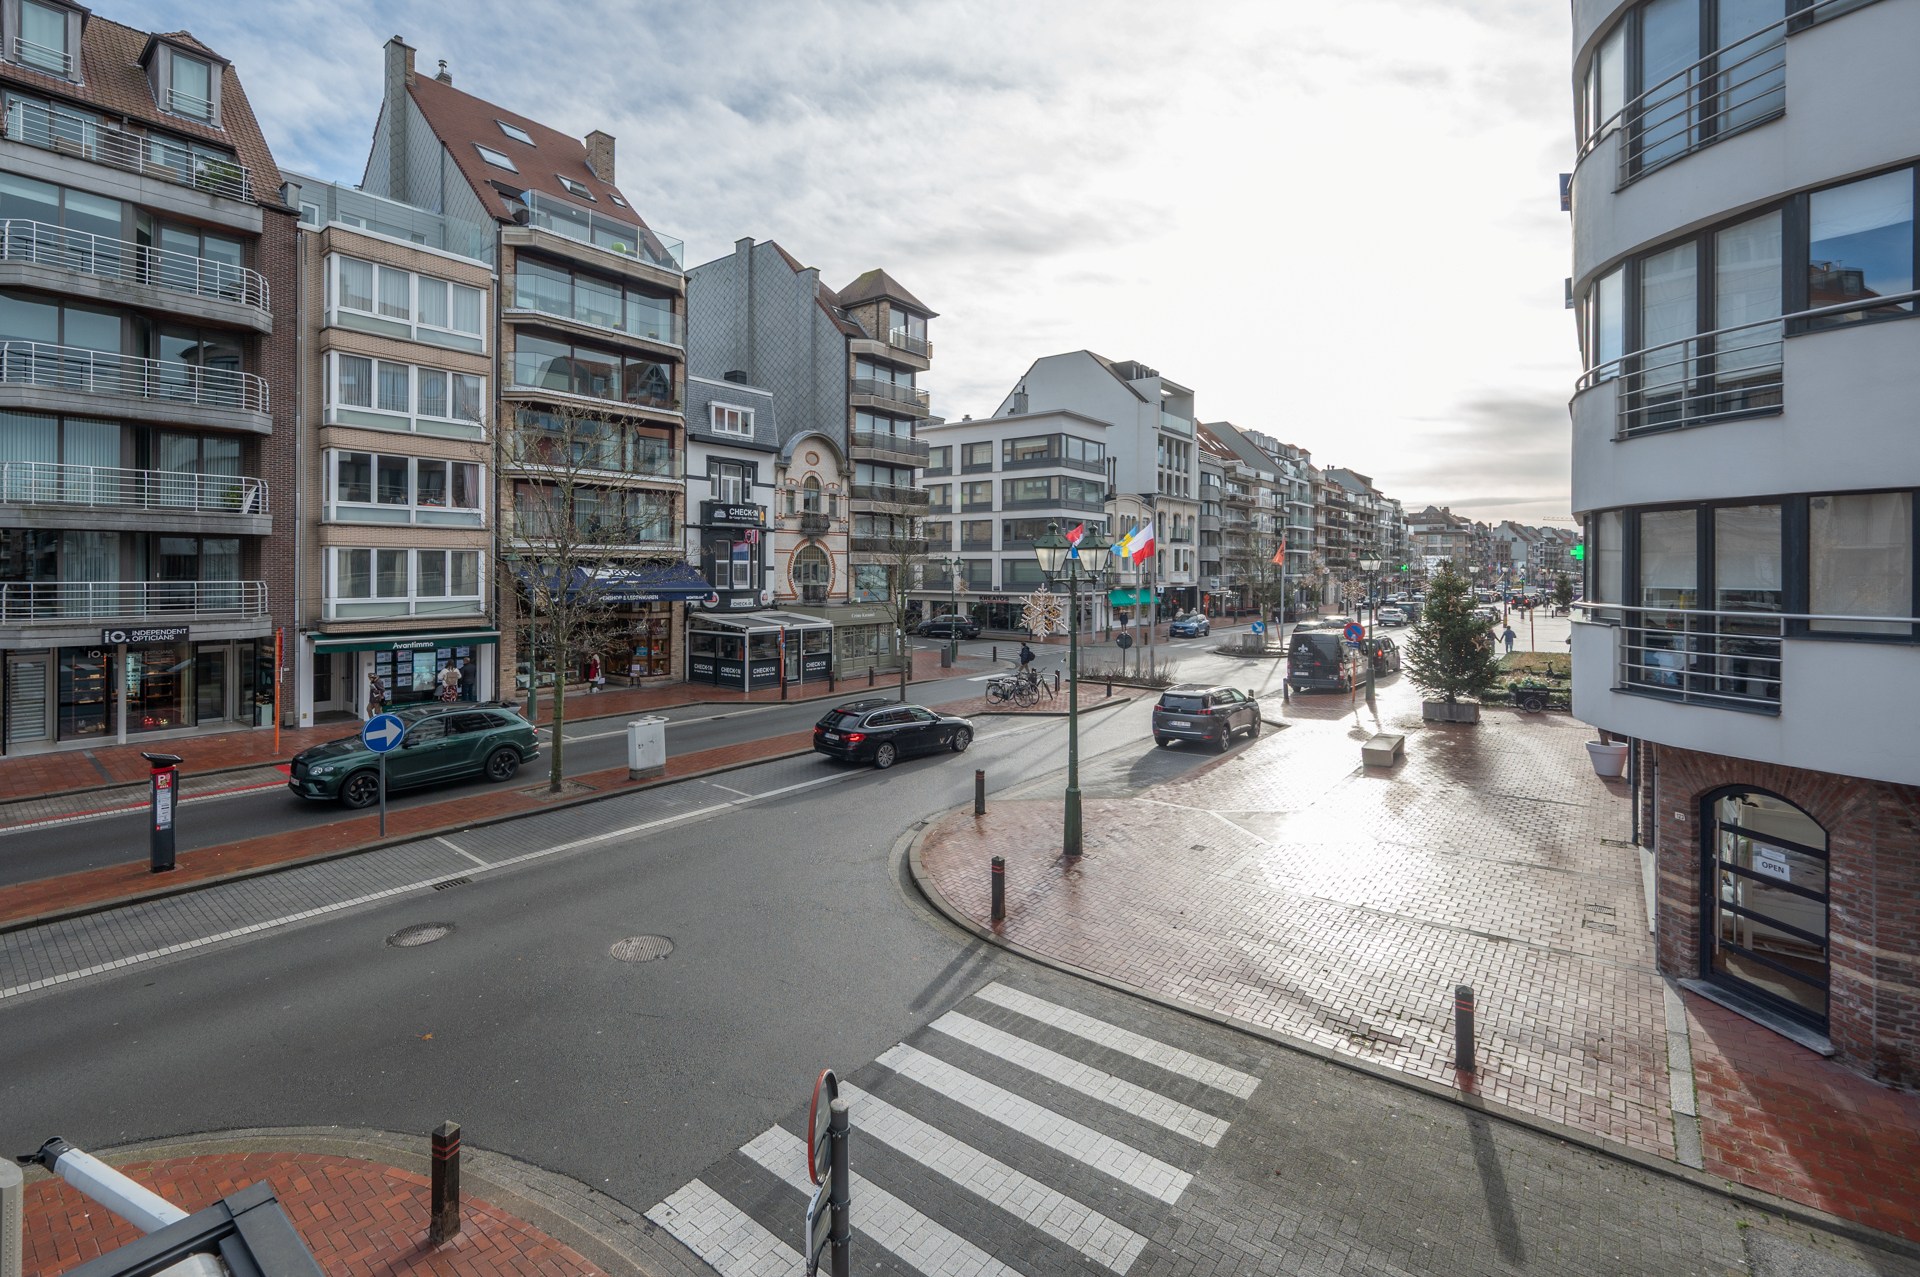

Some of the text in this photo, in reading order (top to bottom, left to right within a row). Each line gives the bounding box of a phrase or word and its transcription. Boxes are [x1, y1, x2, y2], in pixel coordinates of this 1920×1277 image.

[132, 628, 187, 636] INDEPENDENT
[393, 641, 434, 649] Avantimmo
[1761, 861, 1784, 874] OPEN
